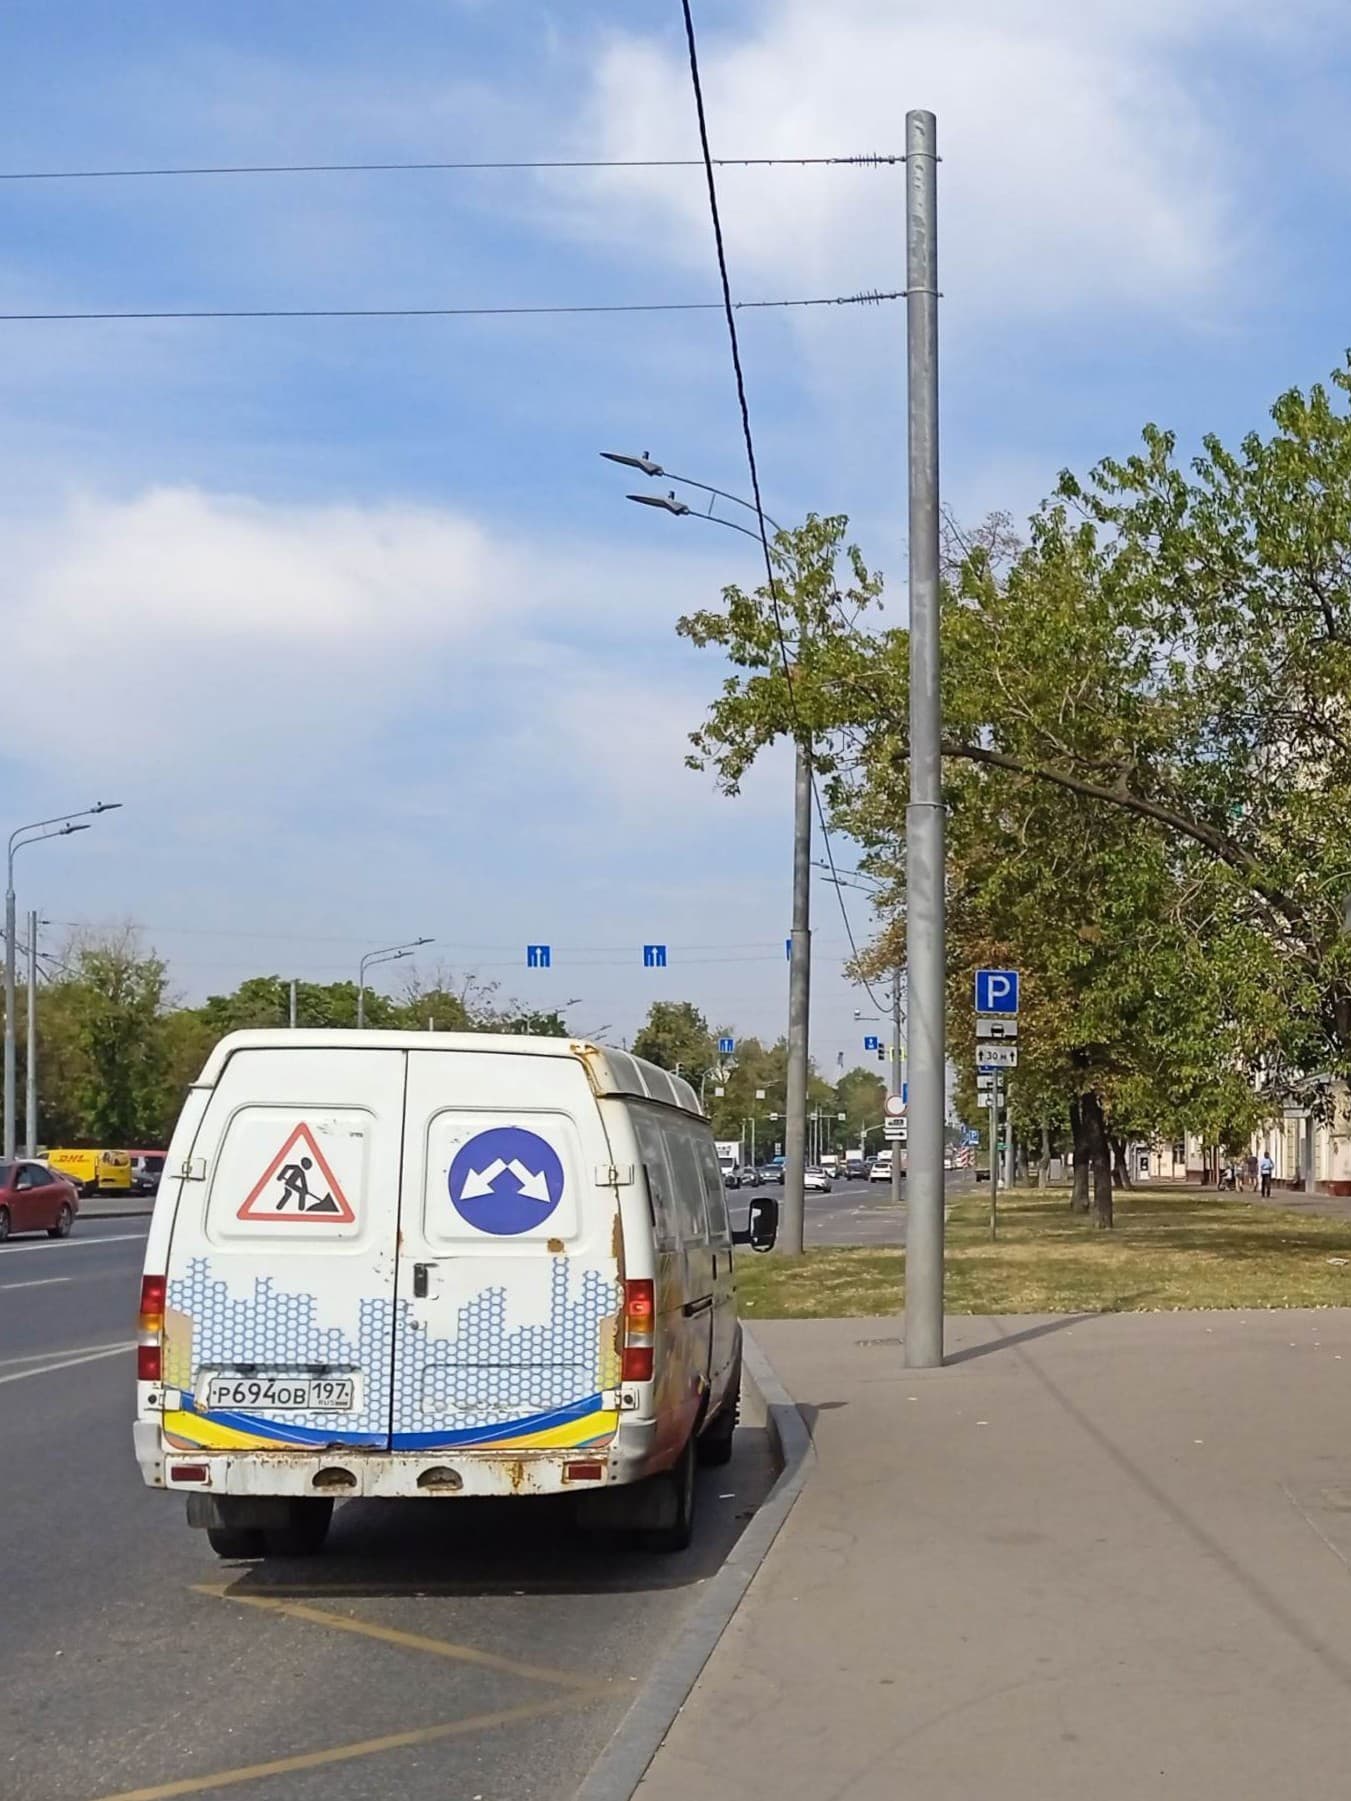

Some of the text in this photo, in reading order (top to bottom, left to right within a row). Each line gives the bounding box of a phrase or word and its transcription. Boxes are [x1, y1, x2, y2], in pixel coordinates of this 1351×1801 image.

[987, 975, 1011, 1009] P
[987, 1051, 998, 1060] 30
[60, 1154, 84, 1163] DHL
[312, 1382, 346, 1400] 197
